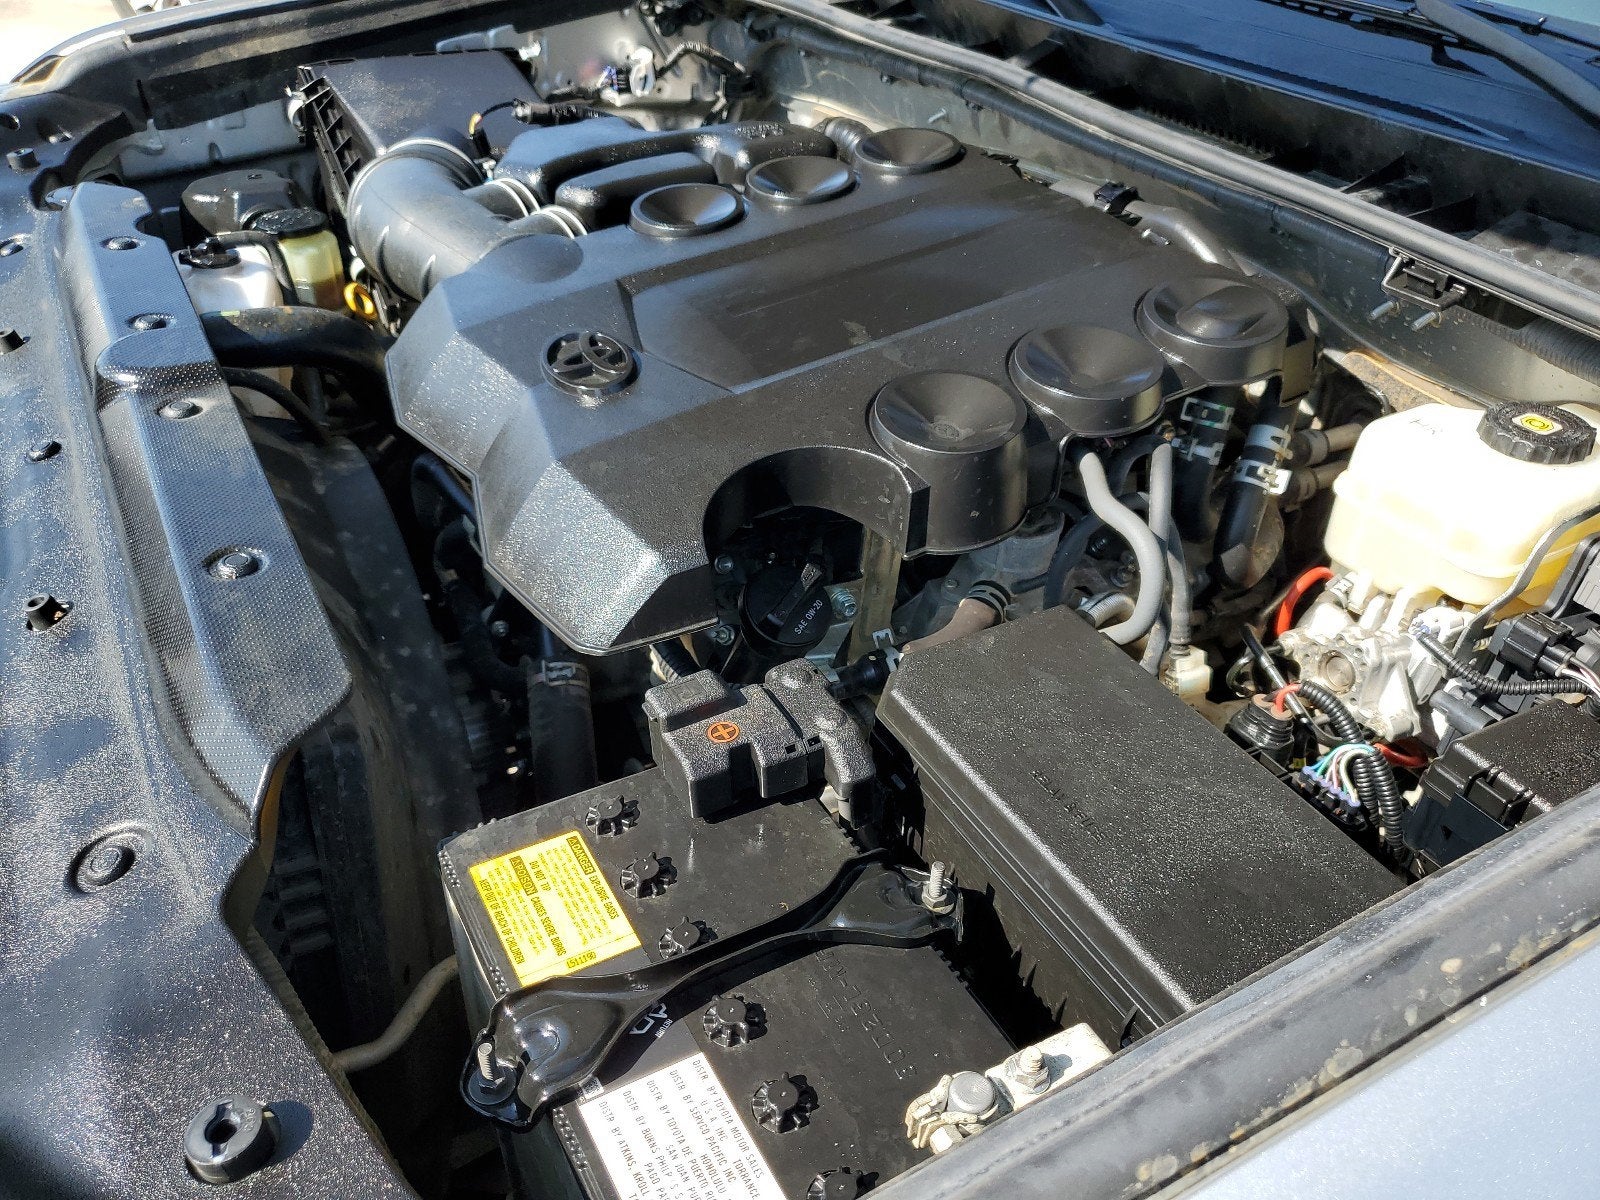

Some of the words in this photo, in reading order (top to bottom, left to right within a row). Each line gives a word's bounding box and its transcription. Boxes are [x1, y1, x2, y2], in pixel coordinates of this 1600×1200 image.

[794, 619, 808, 635] SAE
[805, 599, 823, 620] 0W-20
[529, 860, 540, 870] DO
[533, 869, 547, 881] NOT
[572, 844, 595, 875] DANGER
[588, 874, 610, 903] EXPLOSIVE
[603, 901, 620, 920] GASES
[478, 878, 493, 892] KEEP
[484, 891, 498, 903] OUT
[540, 881, 552, 892] TIP
[489, 902, 501, 911] OF
[493, 910, 509, 929] REACH
[515, 863, 536, 896] POISON
[530, 896, 548, 918] CAUSES
[540, 916, 558, 938] SEVERE
[550, 936, 567, 957] BURNS
[501, 928, 513, 937] OF
[505, 935, 525, 965] CHILDREN
[635, 1115, 646, 1126] BY
[641, 1127, 661, 1154] BURNS
[655, 1155, 673, 1177] PHILP
[659, 1104, 671, 1115] BY
[667, 1117, 686, 1145] TOYOTA
[681, 1145, 693, 1158] DE
[687, 1158, 709, 1189] PUERTO
[682, 1094, 694, 1104] BY
[689, 1106, 711, 1135] SERVCO
[705, 1135, 728, 1166] PACIFIC
[706, 1085, 718, 1096] BY
[714, 1097, 734, 1125] TOYOTA
[730, 1126, 750, 1153] MOTOR
[745, 1153, 765, 1179] SALES
[611, 1126, 623, 1136] BY
[632, 1171, 650, 1197] KROLL
[643, 1162, 661, 1185] PAGO
[665, 1144, 679, 1161] SAN
[674, 1163, 690, 1183] JUAN
[699, 1153, 727, 1194] HONOLULU
[732, 1158, 761, 1200] TORRANCE
